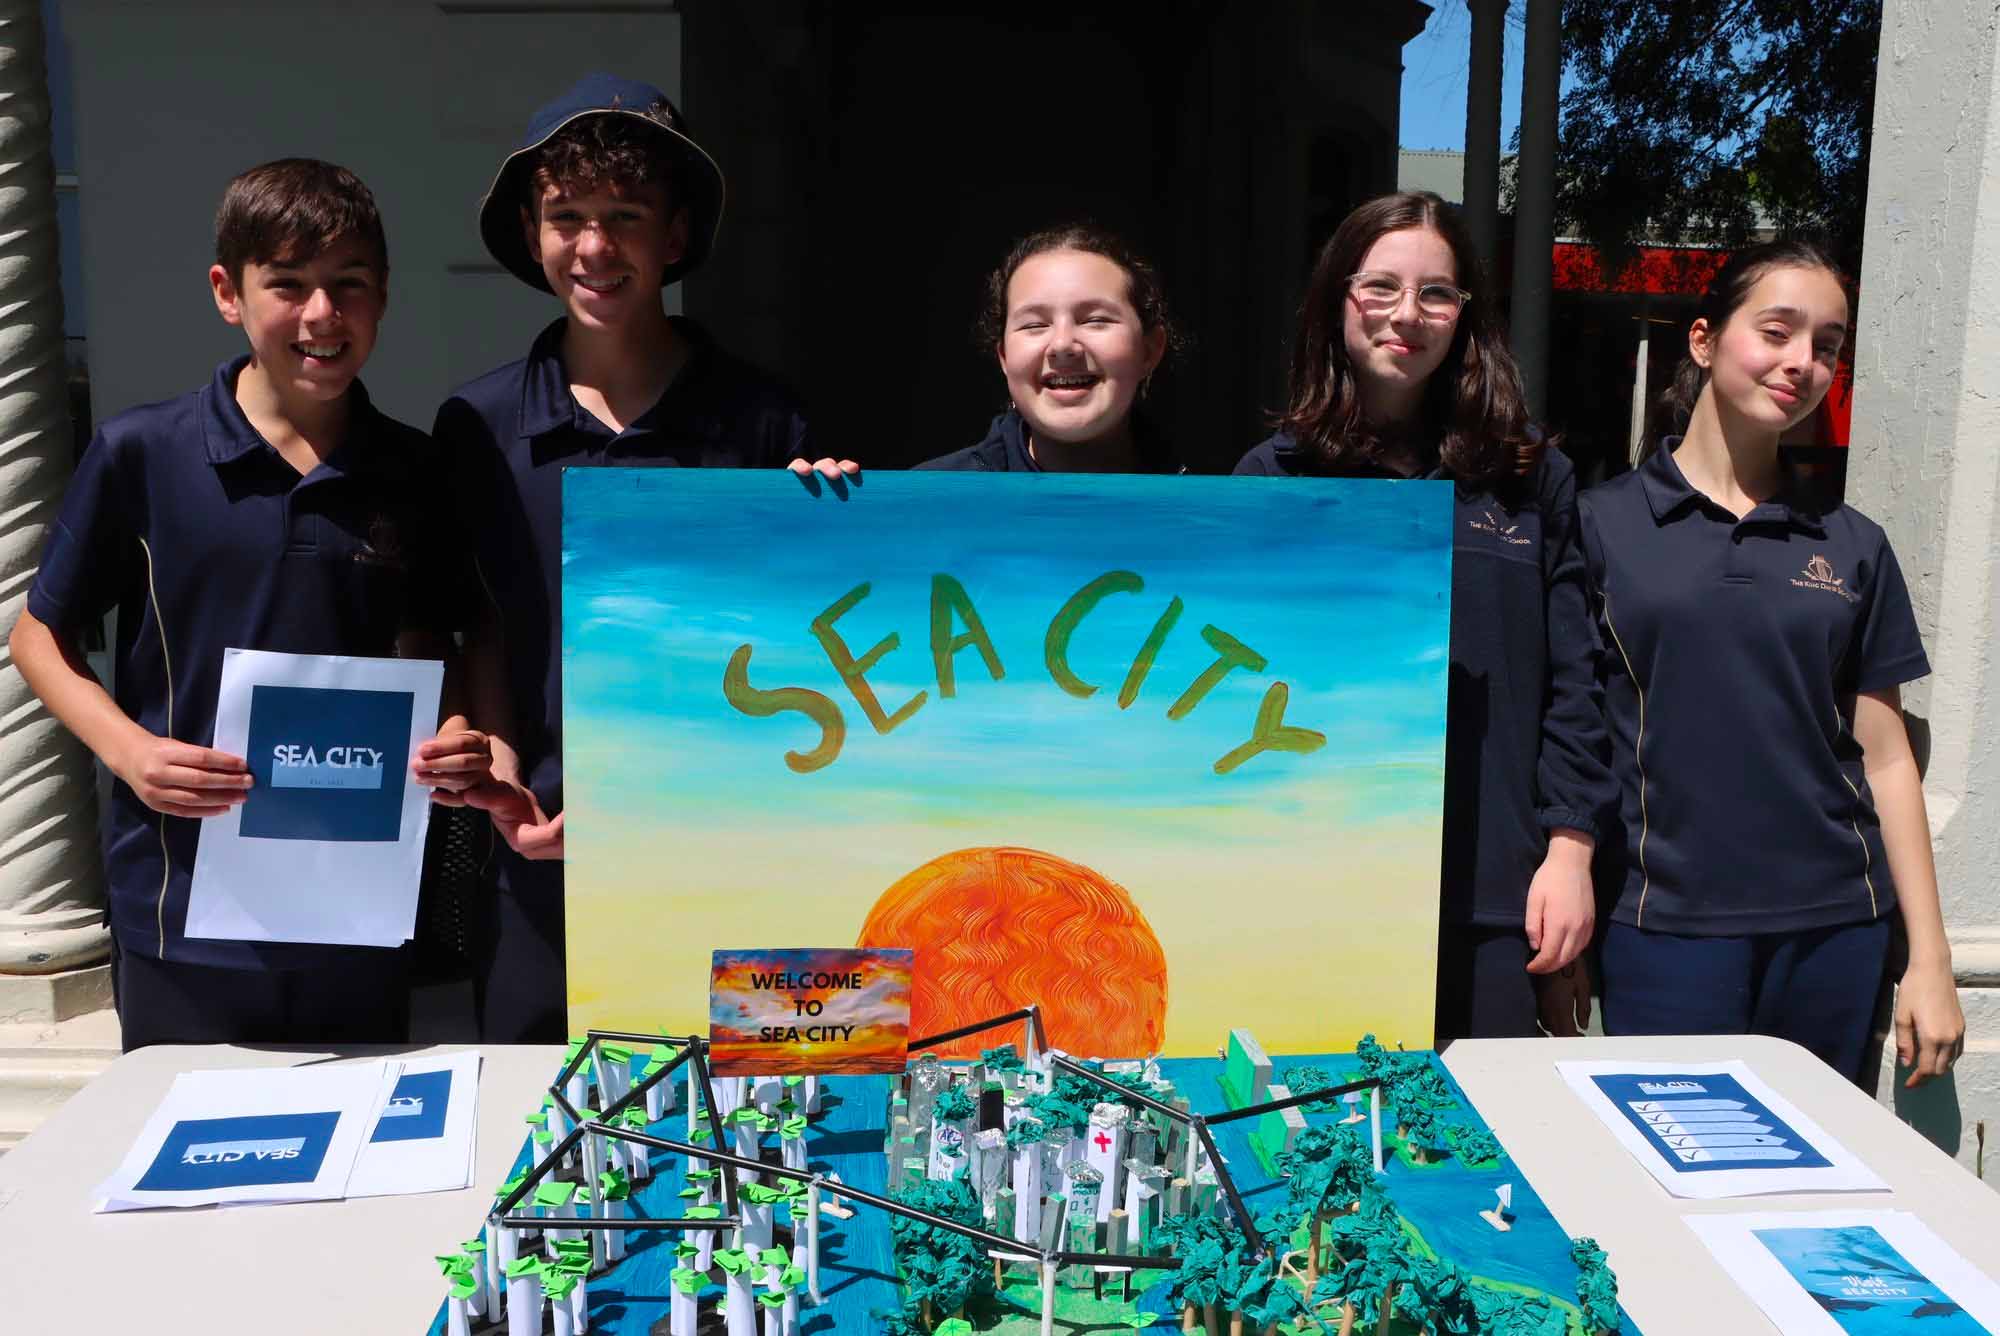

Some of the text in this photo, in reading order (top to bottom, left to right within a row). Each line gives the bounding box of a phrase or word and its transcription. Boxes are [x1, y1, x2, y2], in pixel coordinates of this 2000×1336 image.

[723, 569, 1327, 775] SEA CITY
[274, 745, 383, 768] SEA CITY
[751, 972, 862, 990] WELCOME
[793, 999, 824, 1017] TO
[760, 1025, 855, 1042] SEA CITY
[181, 1148, 300, 1165] SEA CITY
[1841, 1287, 1909, 1297] SEA CITY
